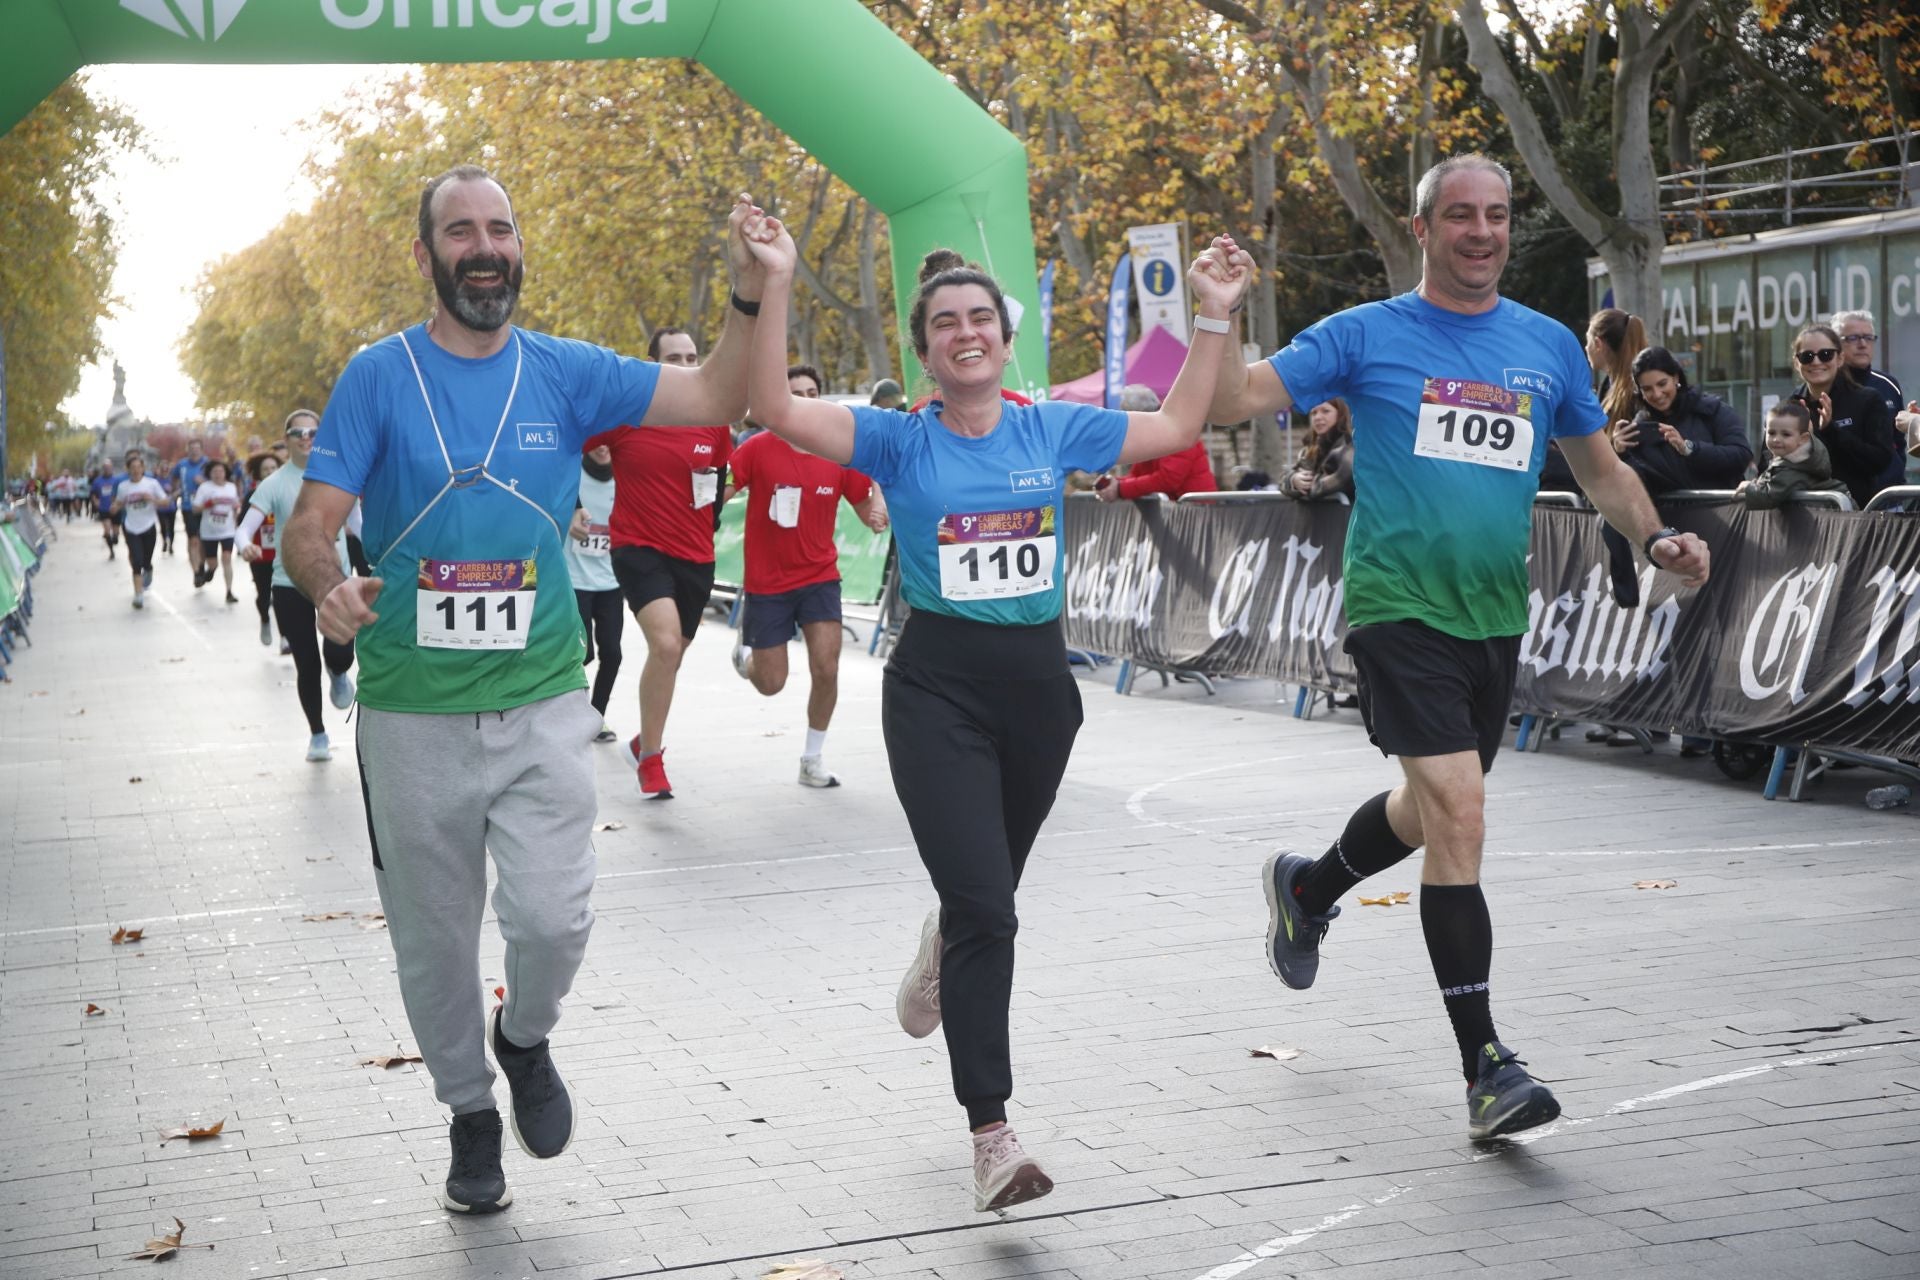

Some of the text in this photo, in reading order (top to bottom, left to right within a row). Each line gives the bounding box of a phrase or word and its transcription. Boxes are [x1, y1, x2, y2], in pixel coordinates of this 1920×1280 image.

[1662, 264, 1872, 337] ALLADOLID
[1512, 375, 1534, 387] AVL
[1462, 382, 1494, 393] CARRERA
[1461, 390, 1504, 404] EMPRESAS
[1437, 409, 1515, 451] 109
[525, 432, 545, 444] AVL
[1018, 476, 1040, 488] AVL
[978, 513, 1011, 523] CARRERA
[1012, 512, 1023, 520] DE
[978, 520, 1023, 532] EMPRESAS
[456, 563, 491, 572] CARRERA
[493, 563, 503, 572] DE
[958, 543, 1040, 582] 110
[456, 571, 503, 582] EMPRESAS
[436, 595, 516, 632] 111
[1517, 555, 1682, 684] astilla
